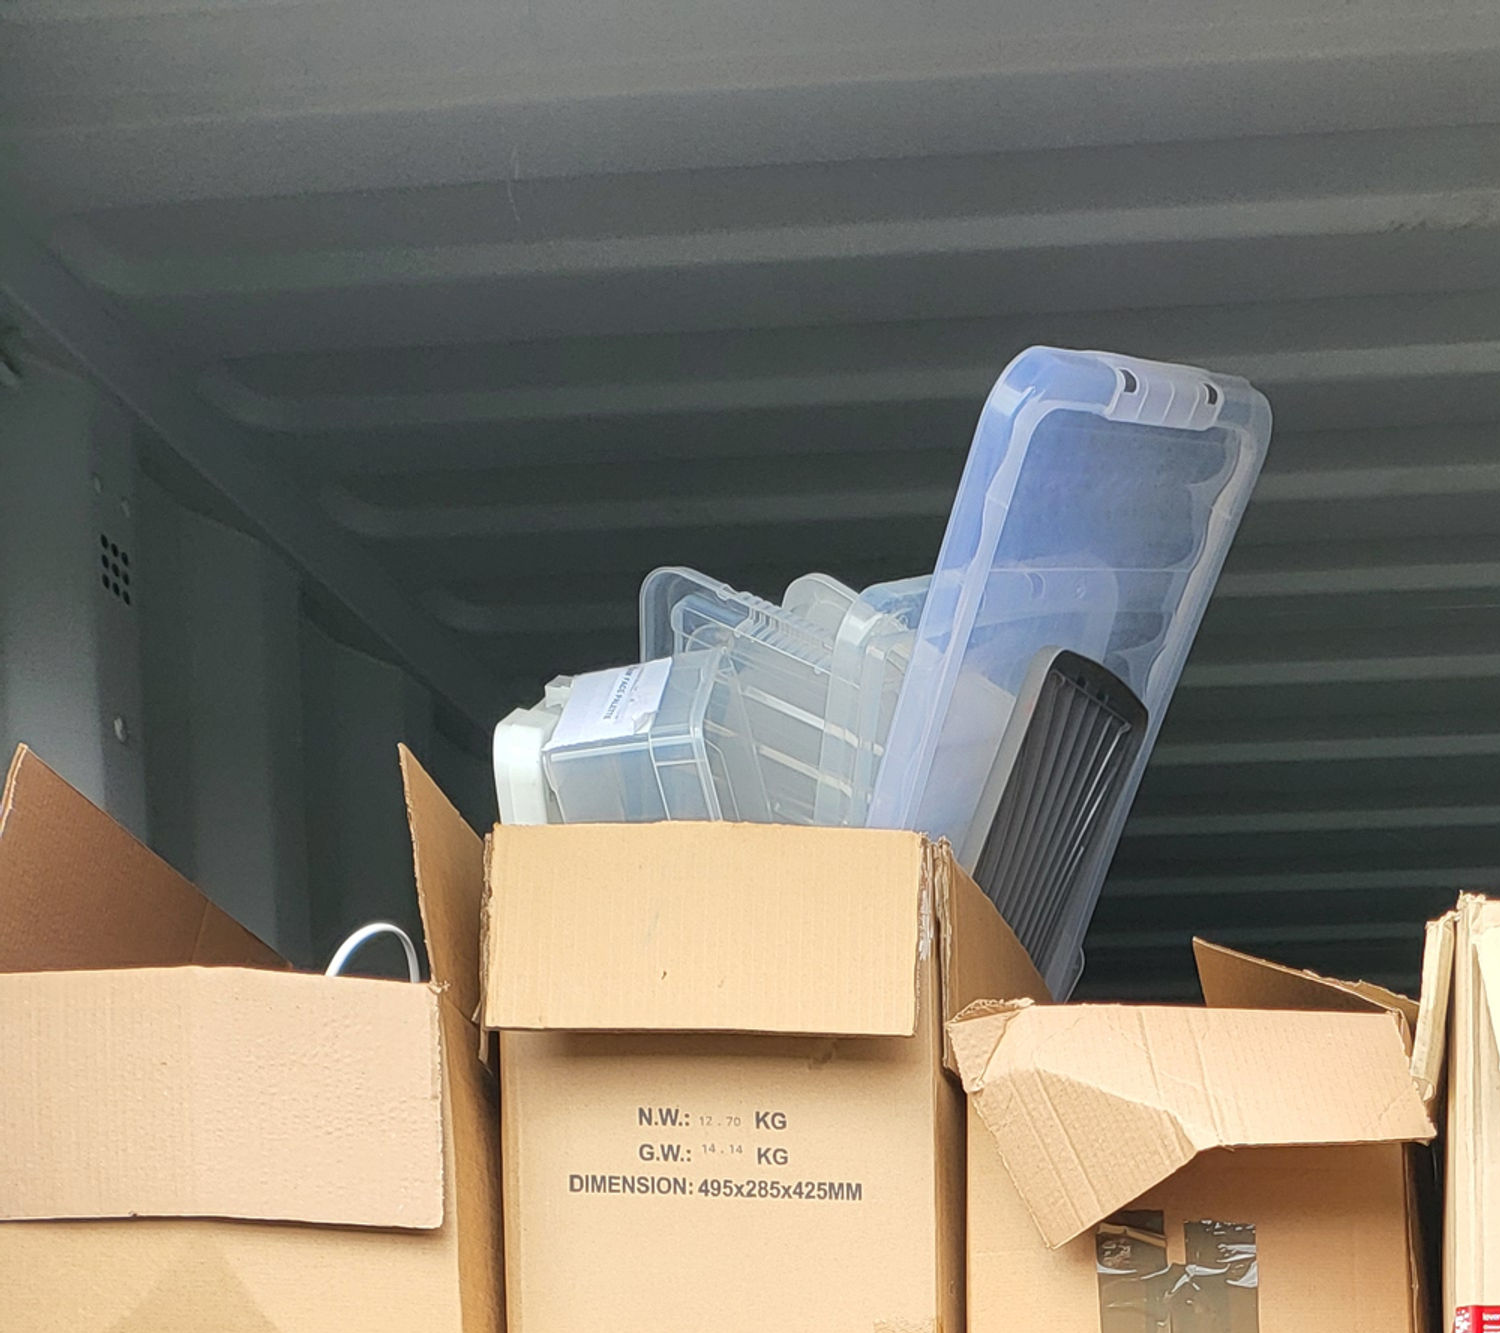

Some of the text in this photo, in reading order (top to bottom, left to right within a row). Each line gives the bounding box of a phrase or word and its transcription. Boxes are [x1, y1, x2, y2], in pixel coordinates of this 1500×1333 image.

[638, 1107, 690, 1127] N.W.:
[755, 1111, 787, 1130] KG
[639, 1143, 692, 1162] G.W.:
[757, 1148, 788, 1165] KG
[569, 1174, 863, 1200] DIMENSION: 495x285x425MM
